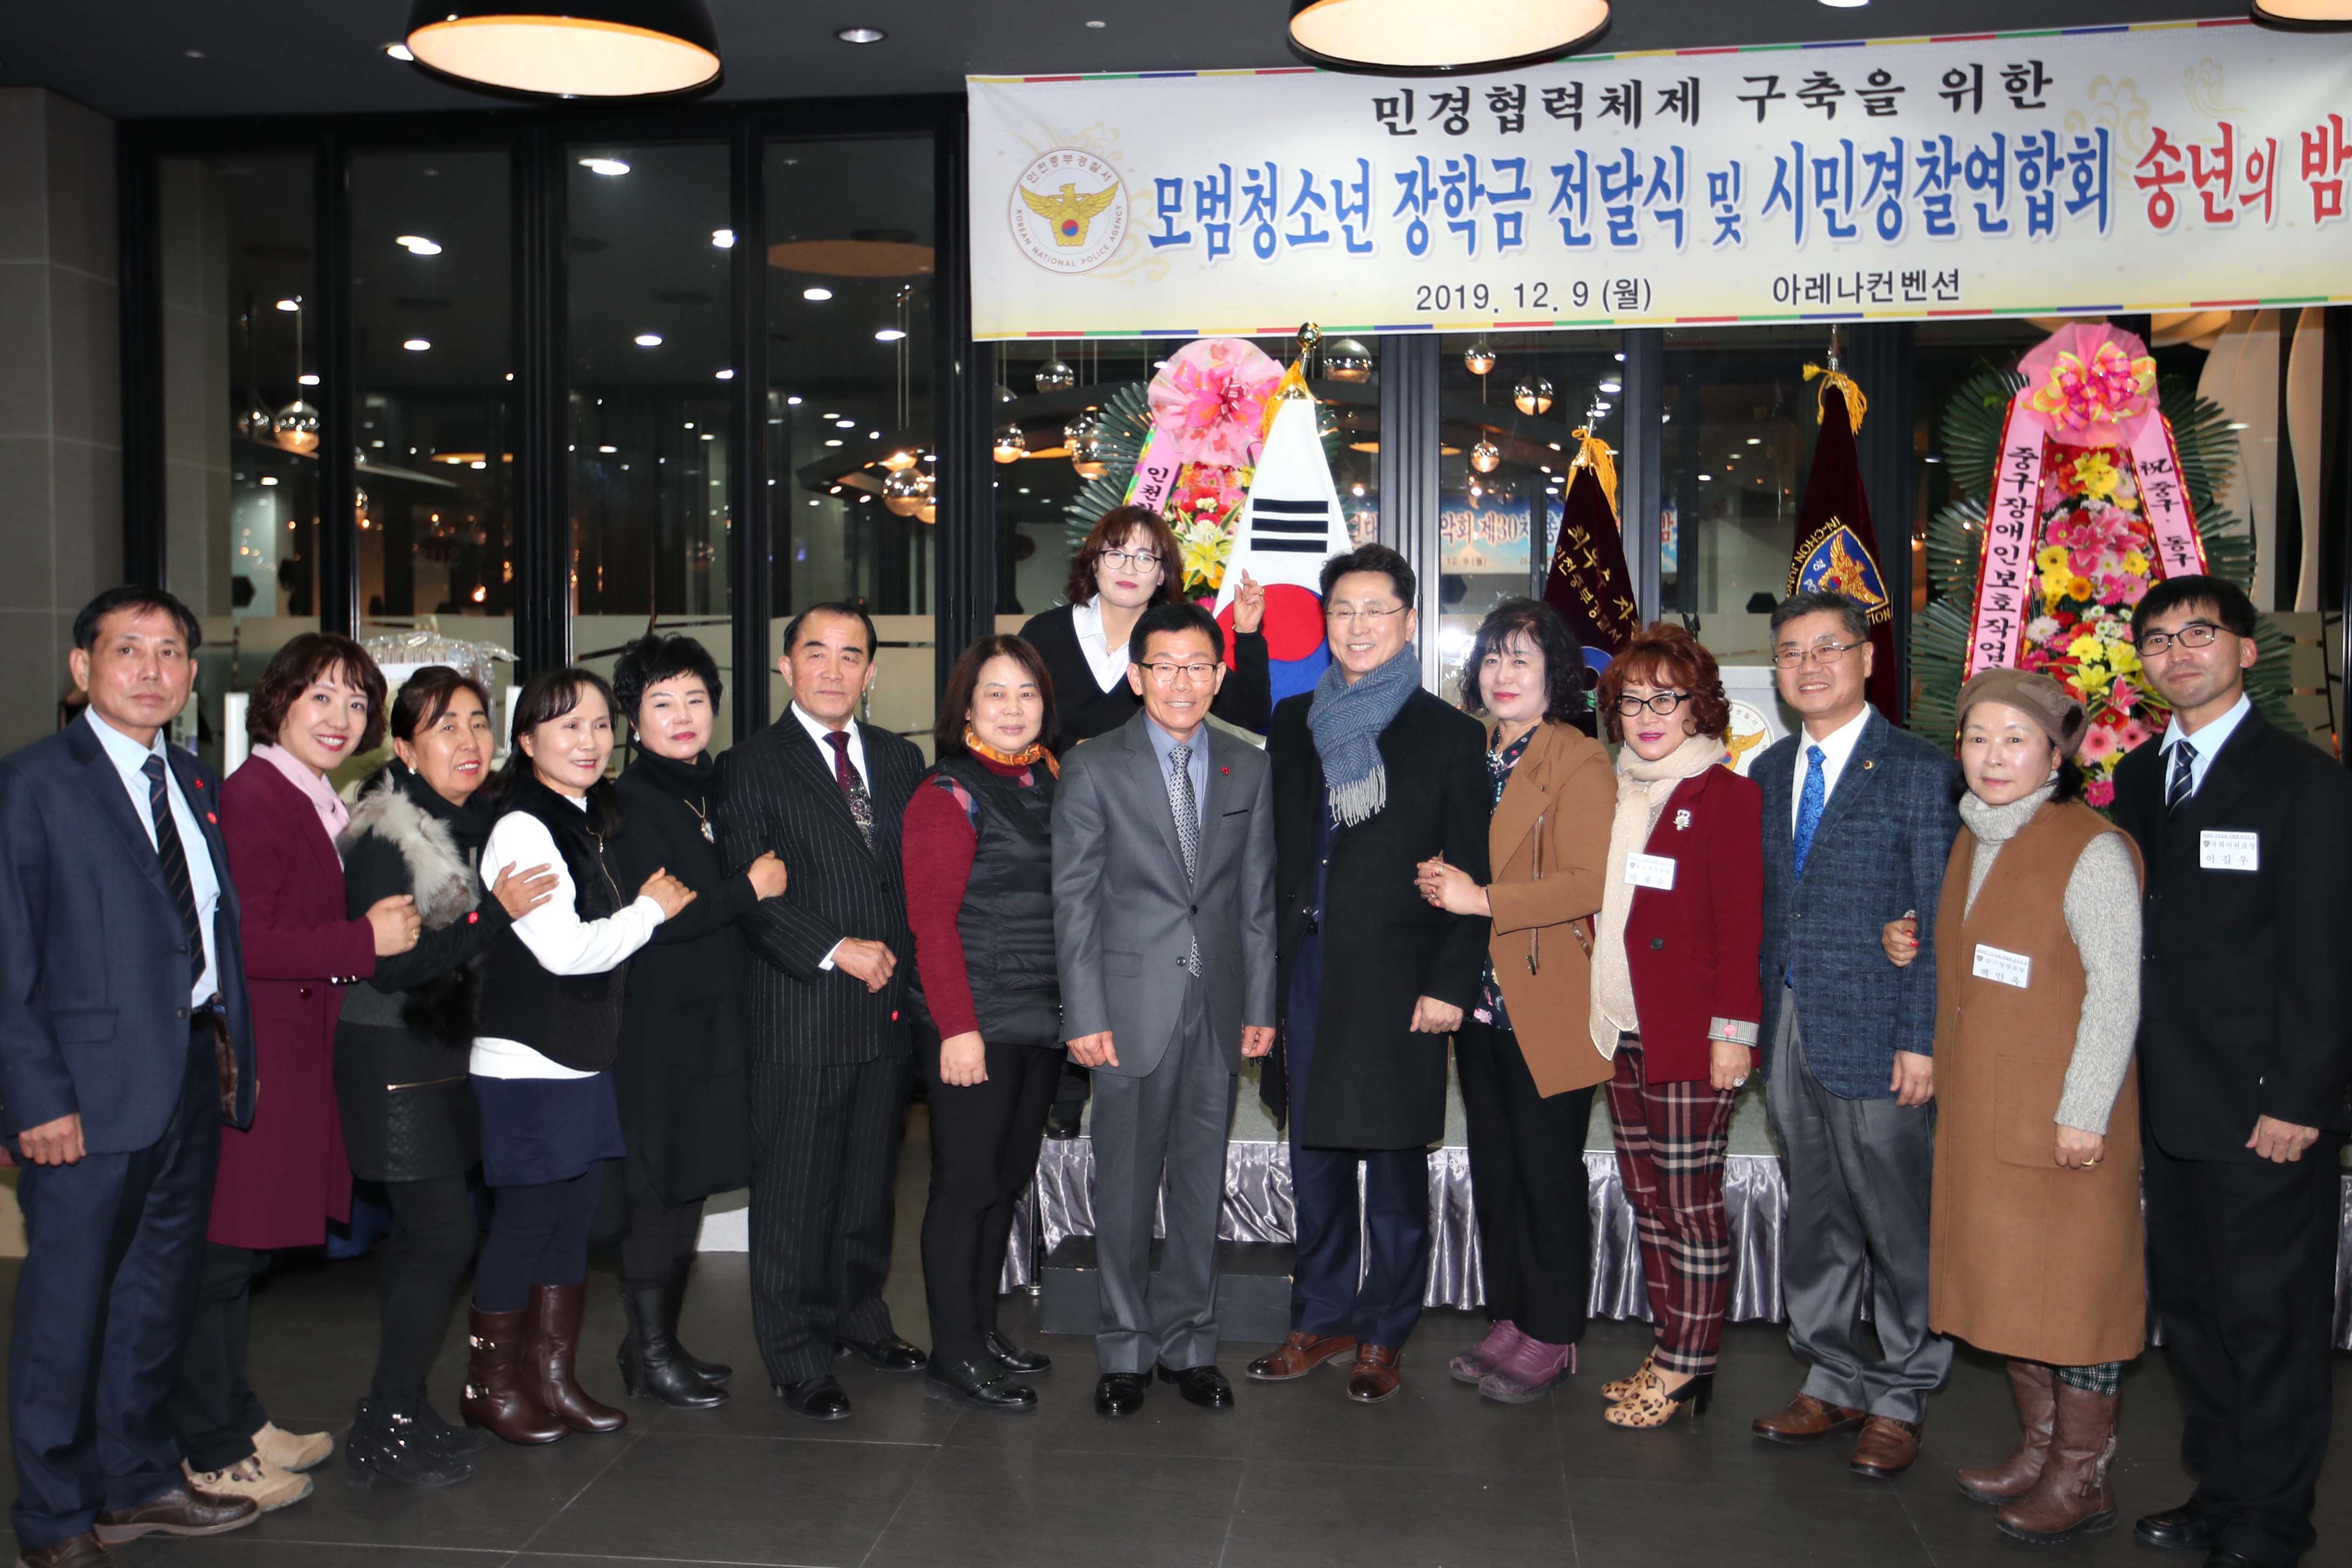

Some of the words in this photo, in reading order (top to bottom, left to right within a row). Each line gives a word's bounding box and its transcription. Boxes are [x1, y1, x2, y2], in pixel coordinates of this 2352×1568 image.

[1371, 76, 1700, 136] 민경협력체제
[1737, 67, 1906, 123] 구축을
[1937, 59, 2054, 115] 위한
[1026, 155, 1112, 184] 인천중부경찰서
[1148, 157, 1373, 261] 모범청소년
[1393, 152, 1531, 256] 장학금
[1550, 146, 1684, 249] 전달식
[1708, 160, 1742, 246] 및
[1761, 127, 2109, 245] 시민경찰연합회
[2134, 122, 2277, 229] 송년의
[2300, 113, 2352, 225] 밤
[1016, 209, 1031, 245] KOREAN
[1032, 246, 1076, 267] NATIONAL
[1081, 243, 1110, 265] POLICE
[1109, 205, 1123, 243] AGENCY
[1416, 283, 1500, 314] 2019.
[1514, 282, 1558, 312] 12.
[1572, 280, 1589, 307] 9
[1602, 277, 1651, 312] (월)
[1772, 268, 1961, 306] 아레나컨벤션
[1977, 446, 2040, 669] 중구장애인보호작업
